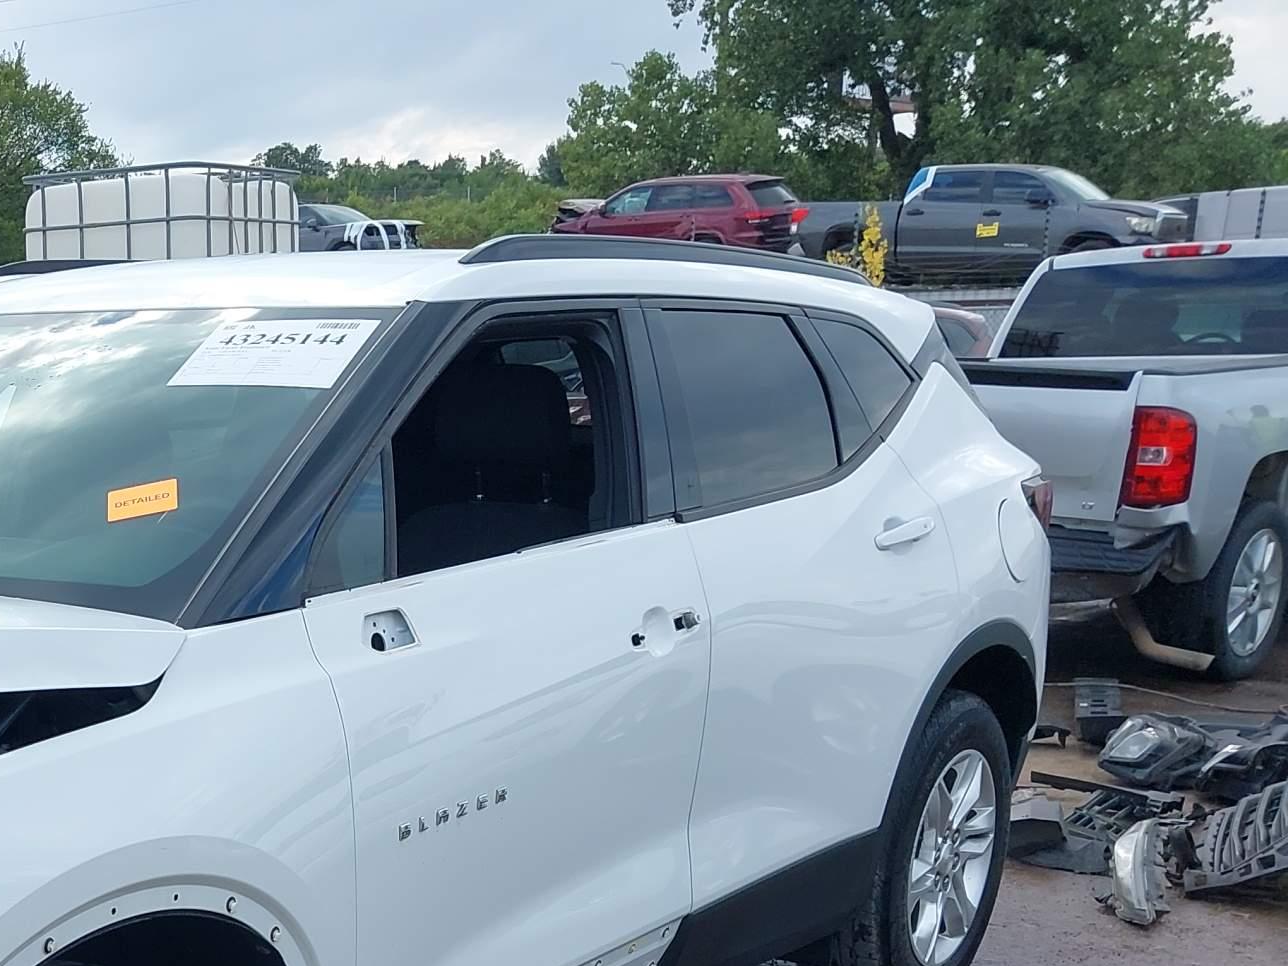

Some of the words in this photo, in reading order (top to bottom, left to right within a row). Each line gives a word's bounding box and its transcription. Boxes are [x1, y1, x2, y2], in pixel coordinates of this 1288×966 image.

[219, 332, 349, 347] 43245144
[114, 492, 170, 508] DETAILED
[398, 786, 509, 842] BLAZER
